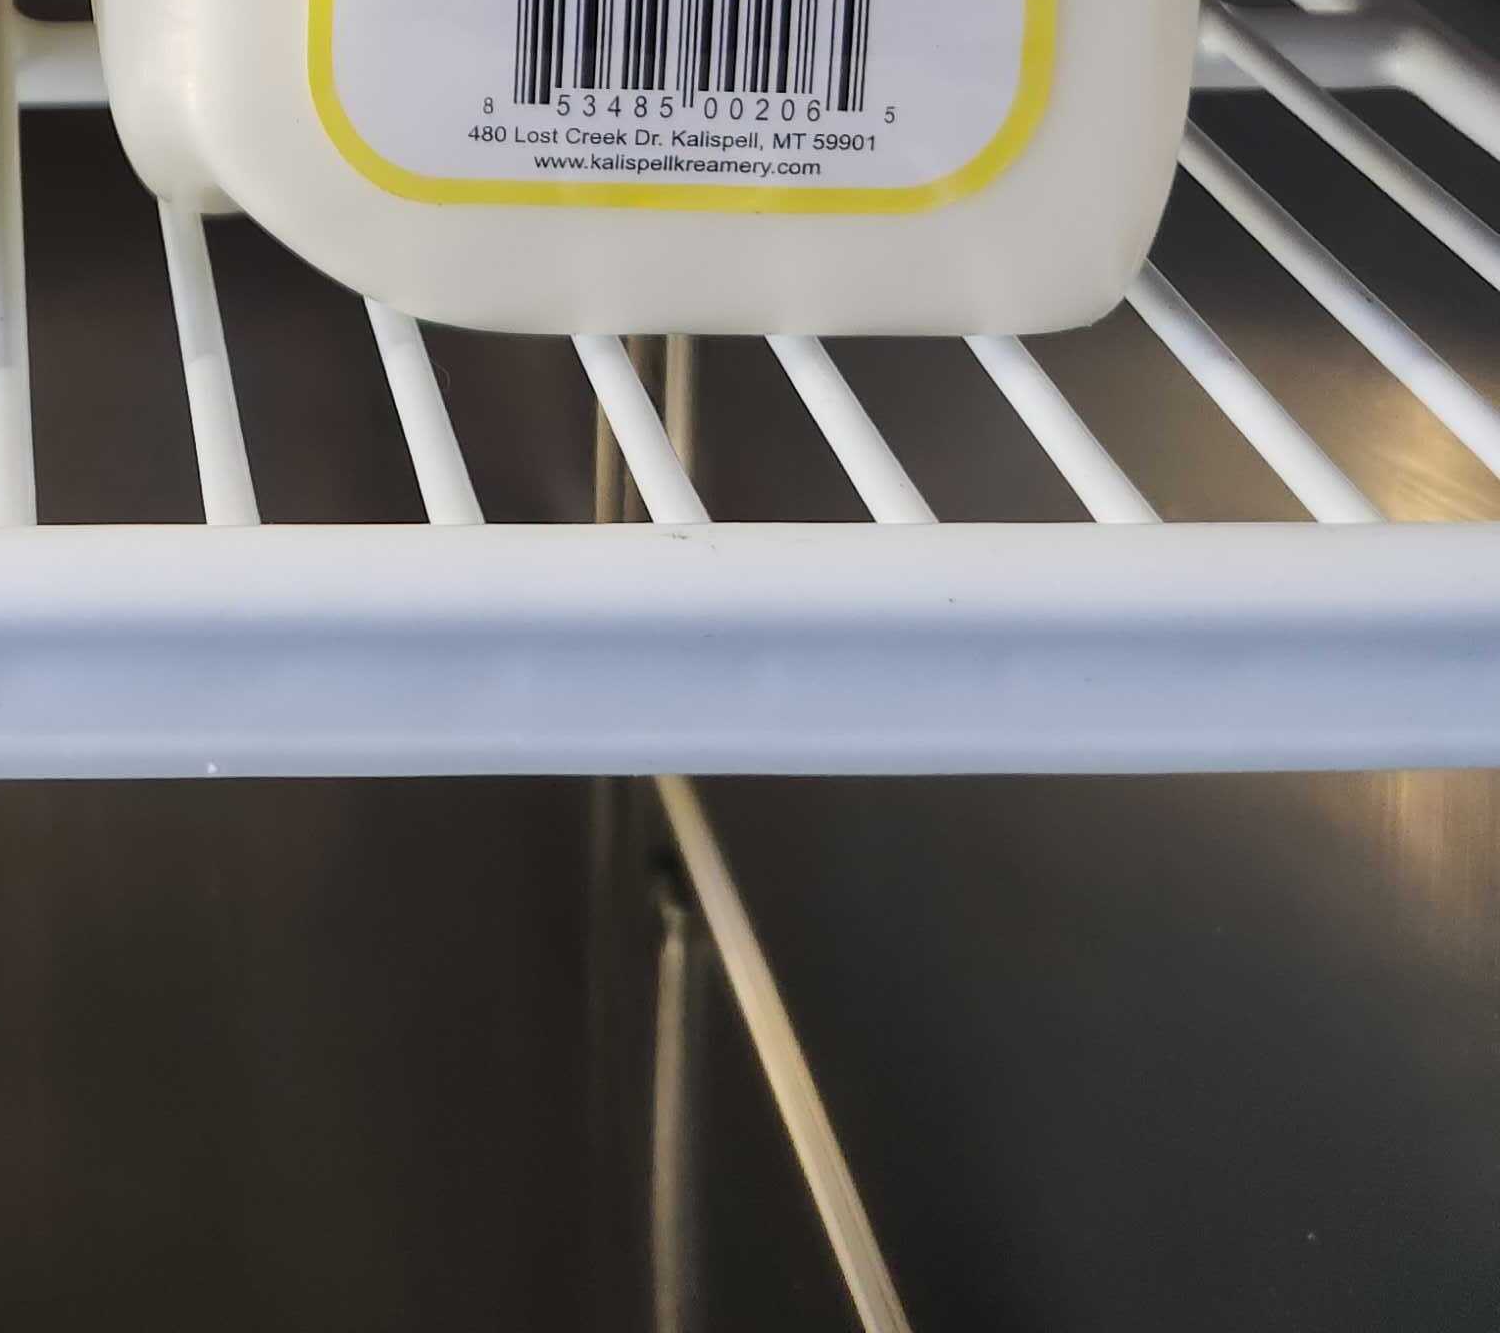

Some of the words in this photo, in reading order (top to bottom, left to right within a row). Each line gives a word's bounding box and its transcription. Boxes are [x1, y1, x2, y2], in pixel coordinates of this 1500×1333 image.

[468, 126, 507, 142] 480
[515, 127, 558, 144] Lost
[566, 128, 626, 145] Creek
[635, 130, 662, 147] Dr.
[672, 130, 765, 151] Kalispell,
[773, 133, 806, 149] MT
[813, 134, 876, 150] 59901
[534, 153, 821, 176] www.kalispellkreamery.com
